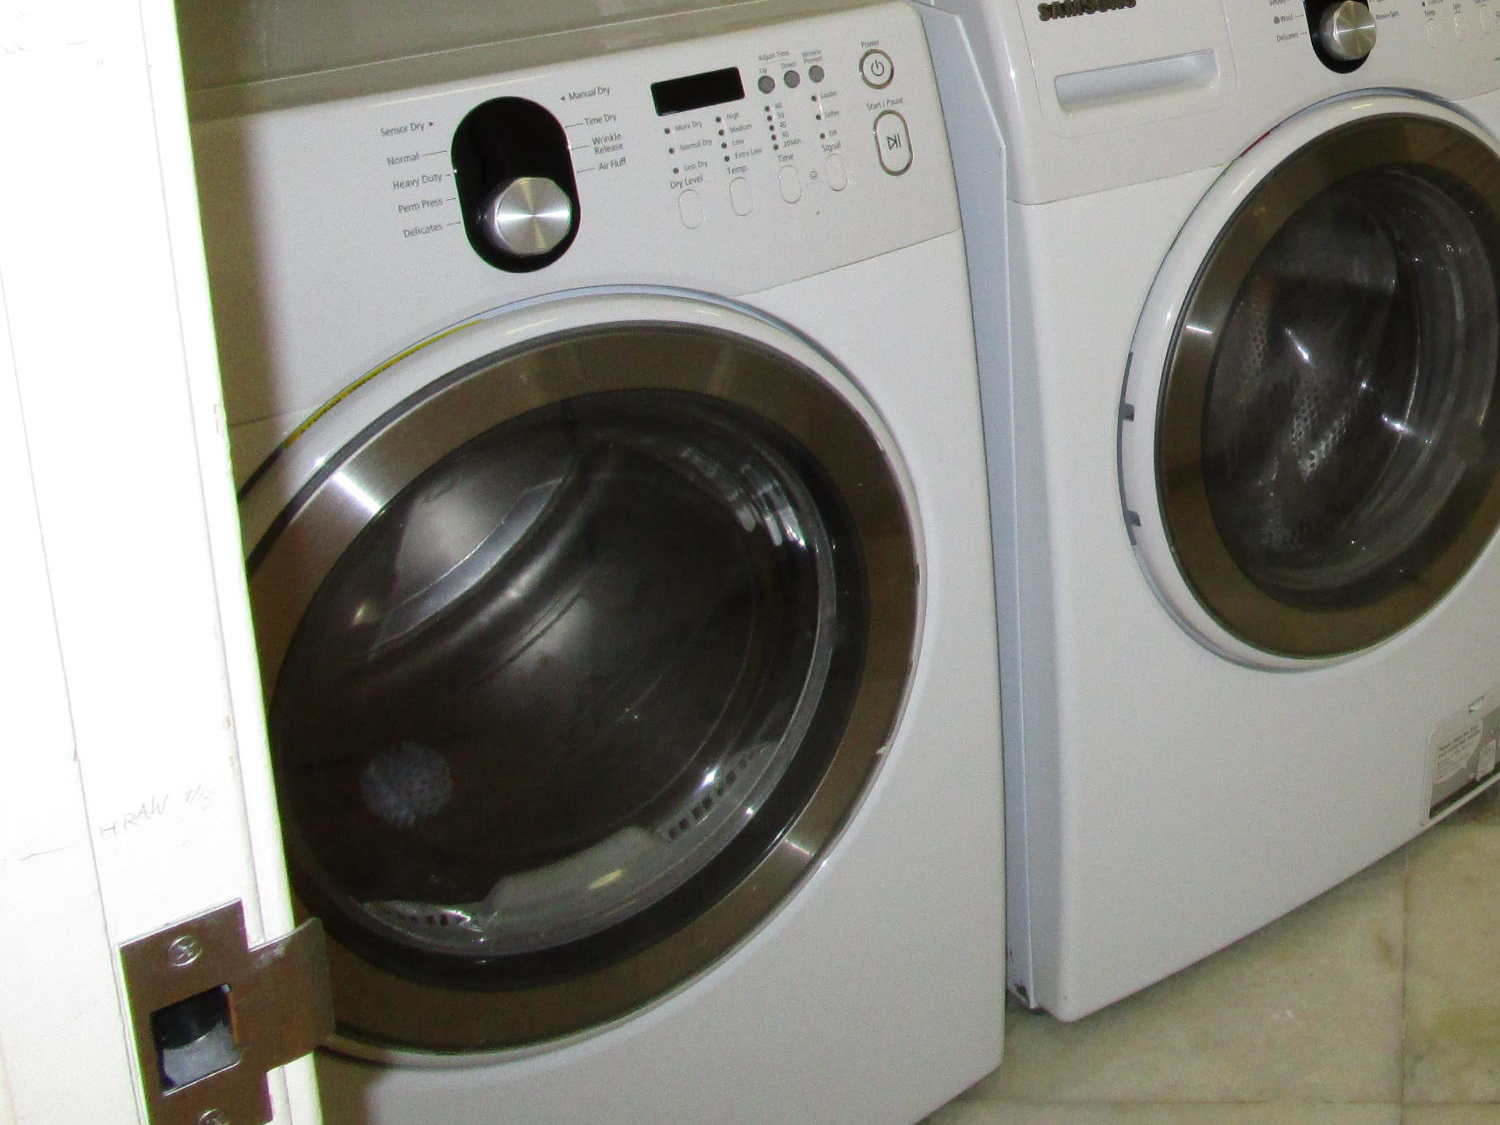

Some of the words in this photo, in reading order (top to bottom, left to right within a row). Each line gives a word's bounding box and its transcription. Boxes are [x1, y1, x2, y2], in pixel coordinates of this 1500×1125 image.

[860, 39, 880, 48] Power
[568, 88, 597, 101] Manual
[597, 86, 610, 96] Dry
[584, 116, 603, 126] Time
[603, 113, 617, 122] Dry
[692, 120, 703, 128] Dry
[380, 125, 408, 137] Sensor
[409, 122, 425, 132] Dry
[729, 123, 753, 133] Medium
[592, 133, 622, 146] Wrinkle
[680, 142, 701, 151] Normal
[702, 139, 713, 147] Dry
[594, 143, 624, 155] Release
[821, 141, 841, 153] Signal
[386, 150, 419, 166] Normal
[599, 162, 609, 171] Air
[610, 156, 627, 168] Fluff
[777, 153, 795, 163] Time
[683, 164, 697, 172] Less
[698, 161, 708, 169] Dry
[392, 179, 420, 191] Heavy
[421, 172, 442, 184] Duty
[670, 179, 683, 190] Dry
[684, 174, 704, 186] Level
[398, 202, 421, 214] Perm
[421, 197, 444, 208] Press
[403, 222, 444, 238] Delicates
